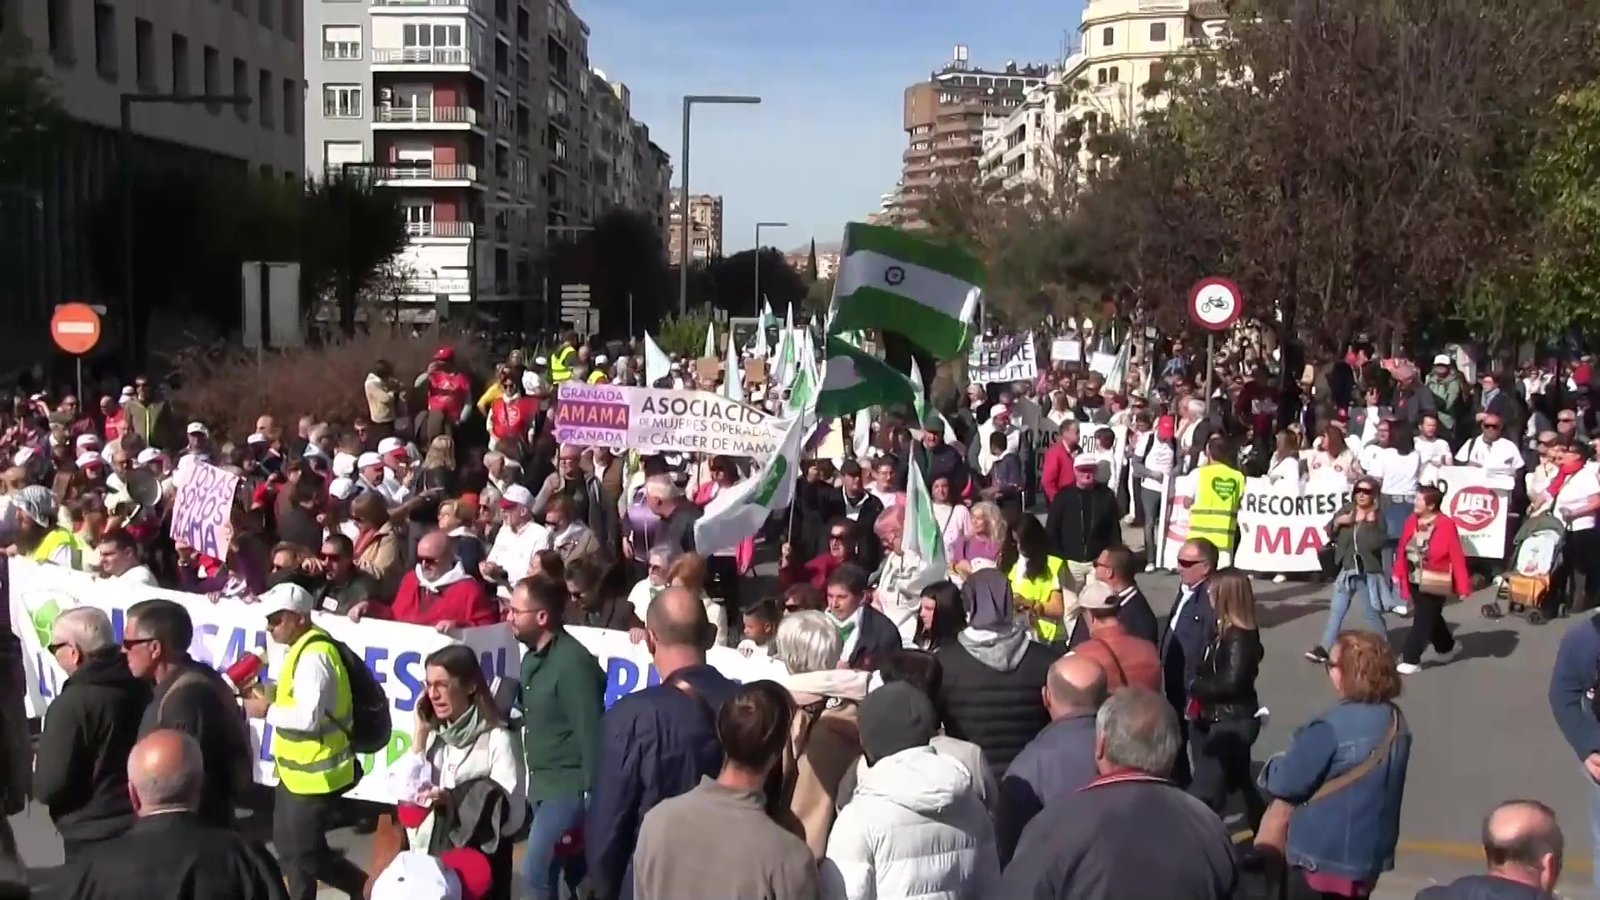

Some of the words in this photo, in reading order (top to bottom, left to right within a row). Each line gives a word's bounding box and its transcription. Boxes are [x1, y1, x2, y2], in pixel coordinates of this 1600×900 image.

[560, 387, 624, 401] GRANADA
[559, 403, 627, 425] AMAMA
[651, 417, 708, 432] MUJERES
[558, 428, 624, 445] GRANADA
[711, 438, 729, 451] DE
[188, 463, 237, 501] TODAS
[180, 484, 228, 526] SOMOS
[1246, 492, 1337, 516] RECORTES
[1455, 492, 1495, 512] UGT
